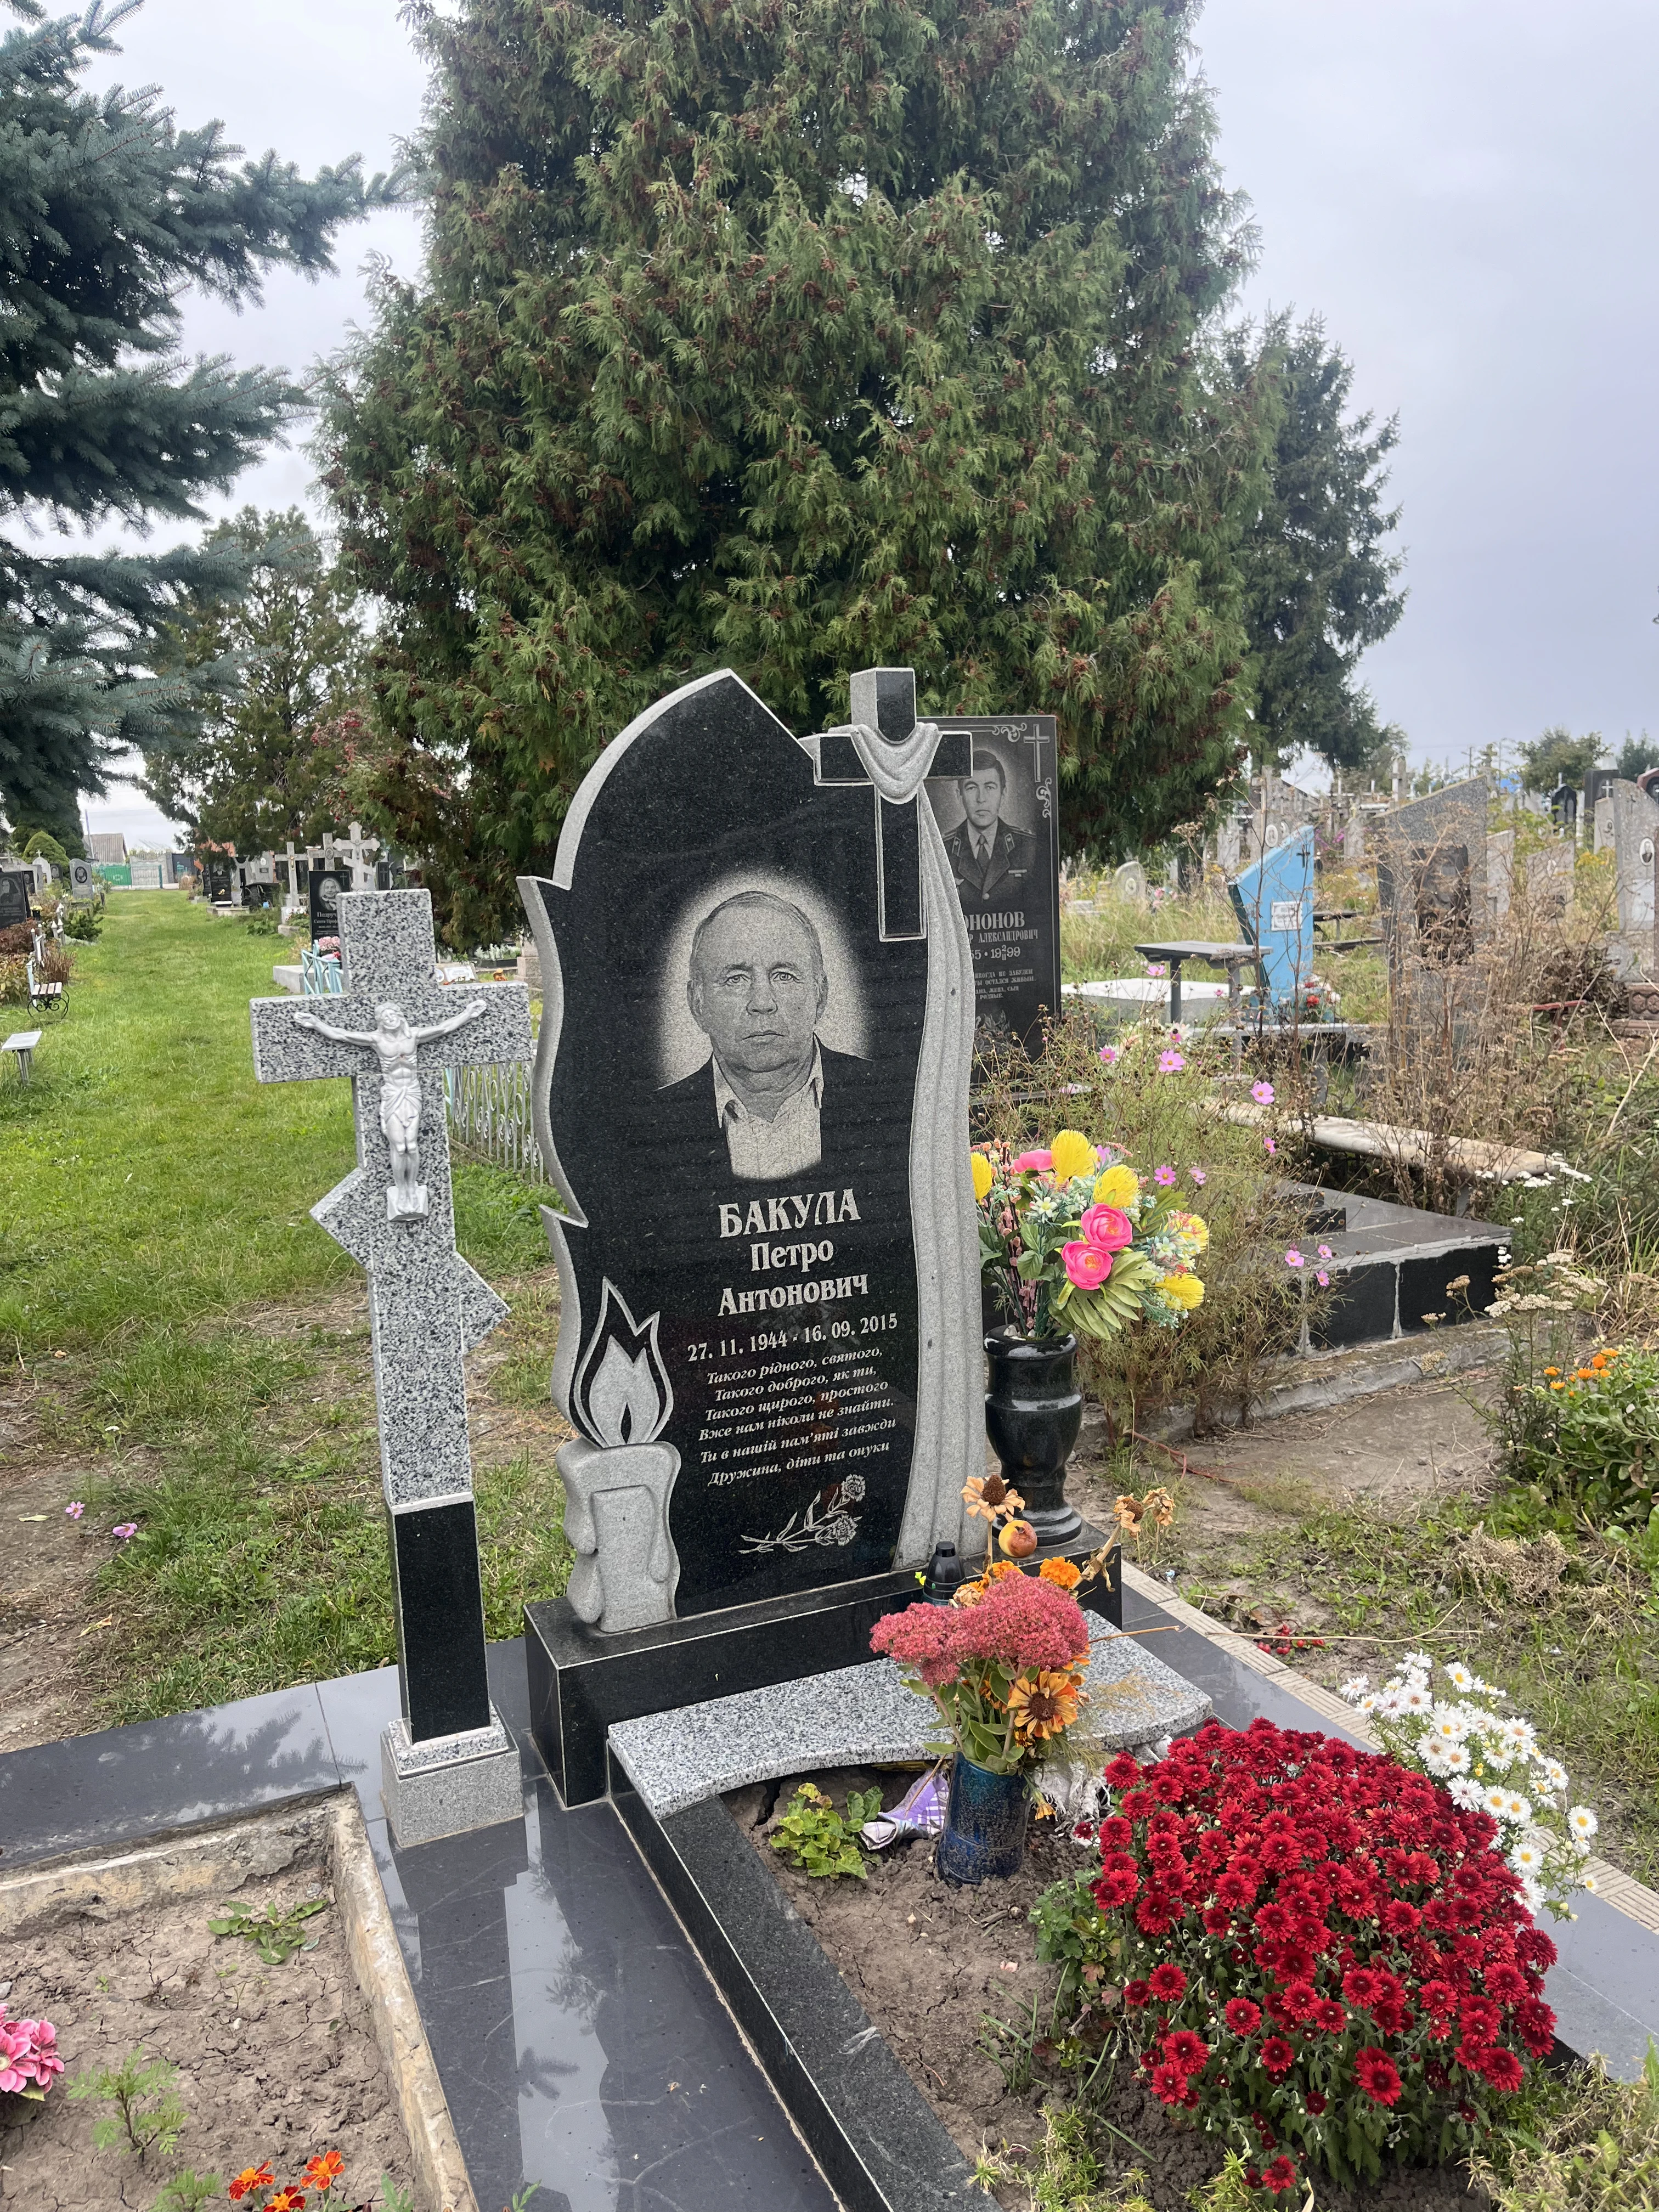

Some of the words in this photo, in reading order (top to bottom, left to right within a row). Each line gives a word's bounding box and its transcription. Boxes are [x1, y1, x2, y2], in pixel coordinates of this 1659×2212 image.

[963, 911, 1025, 931] НОНОВ
[978, 929, 1039, 944] АЛЕКСАНДРОВИЧ
[718, 1188, 862, 1238] БАКУЛА
[749, 1239, 834, 1273] Петро
[717, 1273, 869, 1317] Антонович
[687, 1342, 713, 1362] 27.
[720, 1338, 744, 1357] 11.
[749, 1329, 788, 1352] 1944
[804, 1324, 827, 1344] 16.
[831, 1320, 855, 1339] 09.
[860, 1312, 898, 1335] 2015
[707, 1368, 757, 1385] Такого
[758, 1359, 817, 1380] рідного,
[821, 1347, 883, 1365] святого,
[715, 1385, 765, 1402] Такого
[767, 1374, 828, 1392] доброго,
[832, 1370, 850, 1382] як
[852, 1365, 877, 1378] ти,
[698, 1426, 732, 1441] Вже
[735, 1421, 765, 1435] нам
[768, 1412, 815, 1429] ніколи
[817, 1408, 834, 1420] не
[837, 1398, 894, 1416] знайти.
[705, 1404, 755, 1421] Такого
[758, 1394, 816, 1414] щирого,
[820, 1381, 889, 1403] простого
[700, 1450, 718, 1464] Ти
[720, 1449, 730, 1460] в
[732, 1440, 777, 1458] нашій
[841, 1418, 896, 1437] завжди
[707, 1463, 782, 1487] Дружина,
[786, 1455, 821, 1470] діти
[824, 1450, 845, 1463] та
[848, 1442, 890, 1458] онуки
